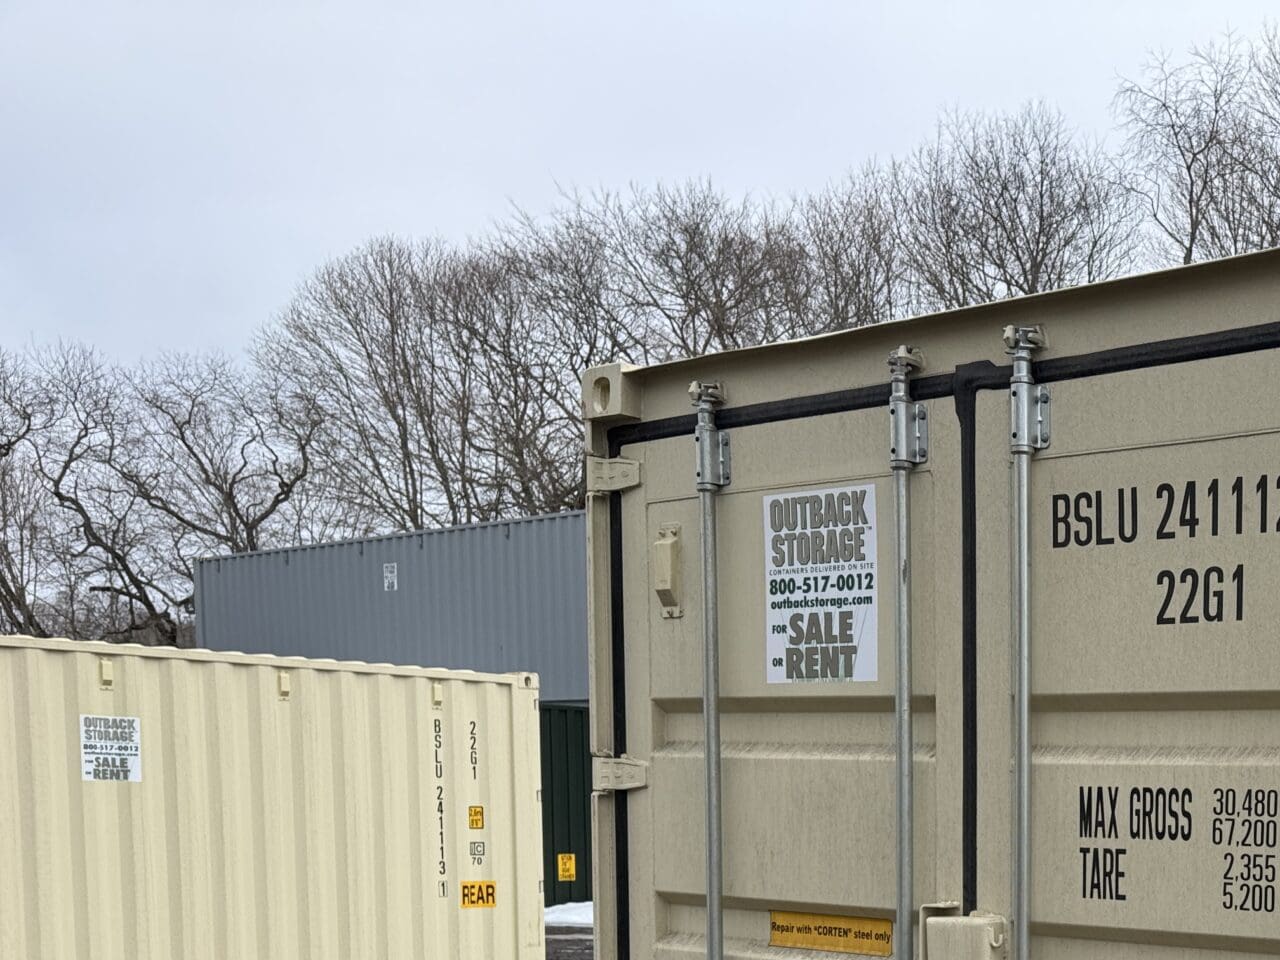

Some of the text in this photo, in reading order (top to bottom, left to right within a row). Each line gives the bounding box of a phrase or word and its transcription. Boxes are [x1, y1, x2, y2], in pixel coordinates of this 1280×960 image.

[769, 490, 868, 533] OUTBACK
[1052, 487, 1138, 548] BSLU
[771, 526, 866, 568] STORAGE
[769, 566, 808, 576] CONTAINERS
[810, 564, 846, 573] DELIVERED
[769, 572, 874, 595] 800-517-0012
[771, 595, 873, 609] outbackstorage.com
[1156, 564, 1244, 625] 22G1
[772, 611, 854, 646] FOR SALE
[772, 645, 857, 679] OR RENT
[83, 717, 135, 731] OUTBACK
[84, 729, 135, 742] STORAGE
[94, 757, 128, 768] SALE
[434, 719, 443, 779] BSLU
[470, 721, 478, 780] 22G1
[93, 768, 131, 780] RENT
[1079, 786, 1119, 839] MAX
[1129, 786, 1193, 841] GROSS
[1212, 788, 1278, 818] 30,480
[436, 786, 446, 876] 241113
[1212, 818, 1277, 848] 67,200
[1079, 847, 1127, 900] TARE
[1223, 852, 1276, 883] 2,355
[462, 885, 496, 905] REAR
[1222, 882, 1275, 912] 5,200
[772, 922, 794, 934] Repair
[796, 924, 812, 934] with
[853, 930, 873, 940] steel
[874, 931, 891, 944] only
